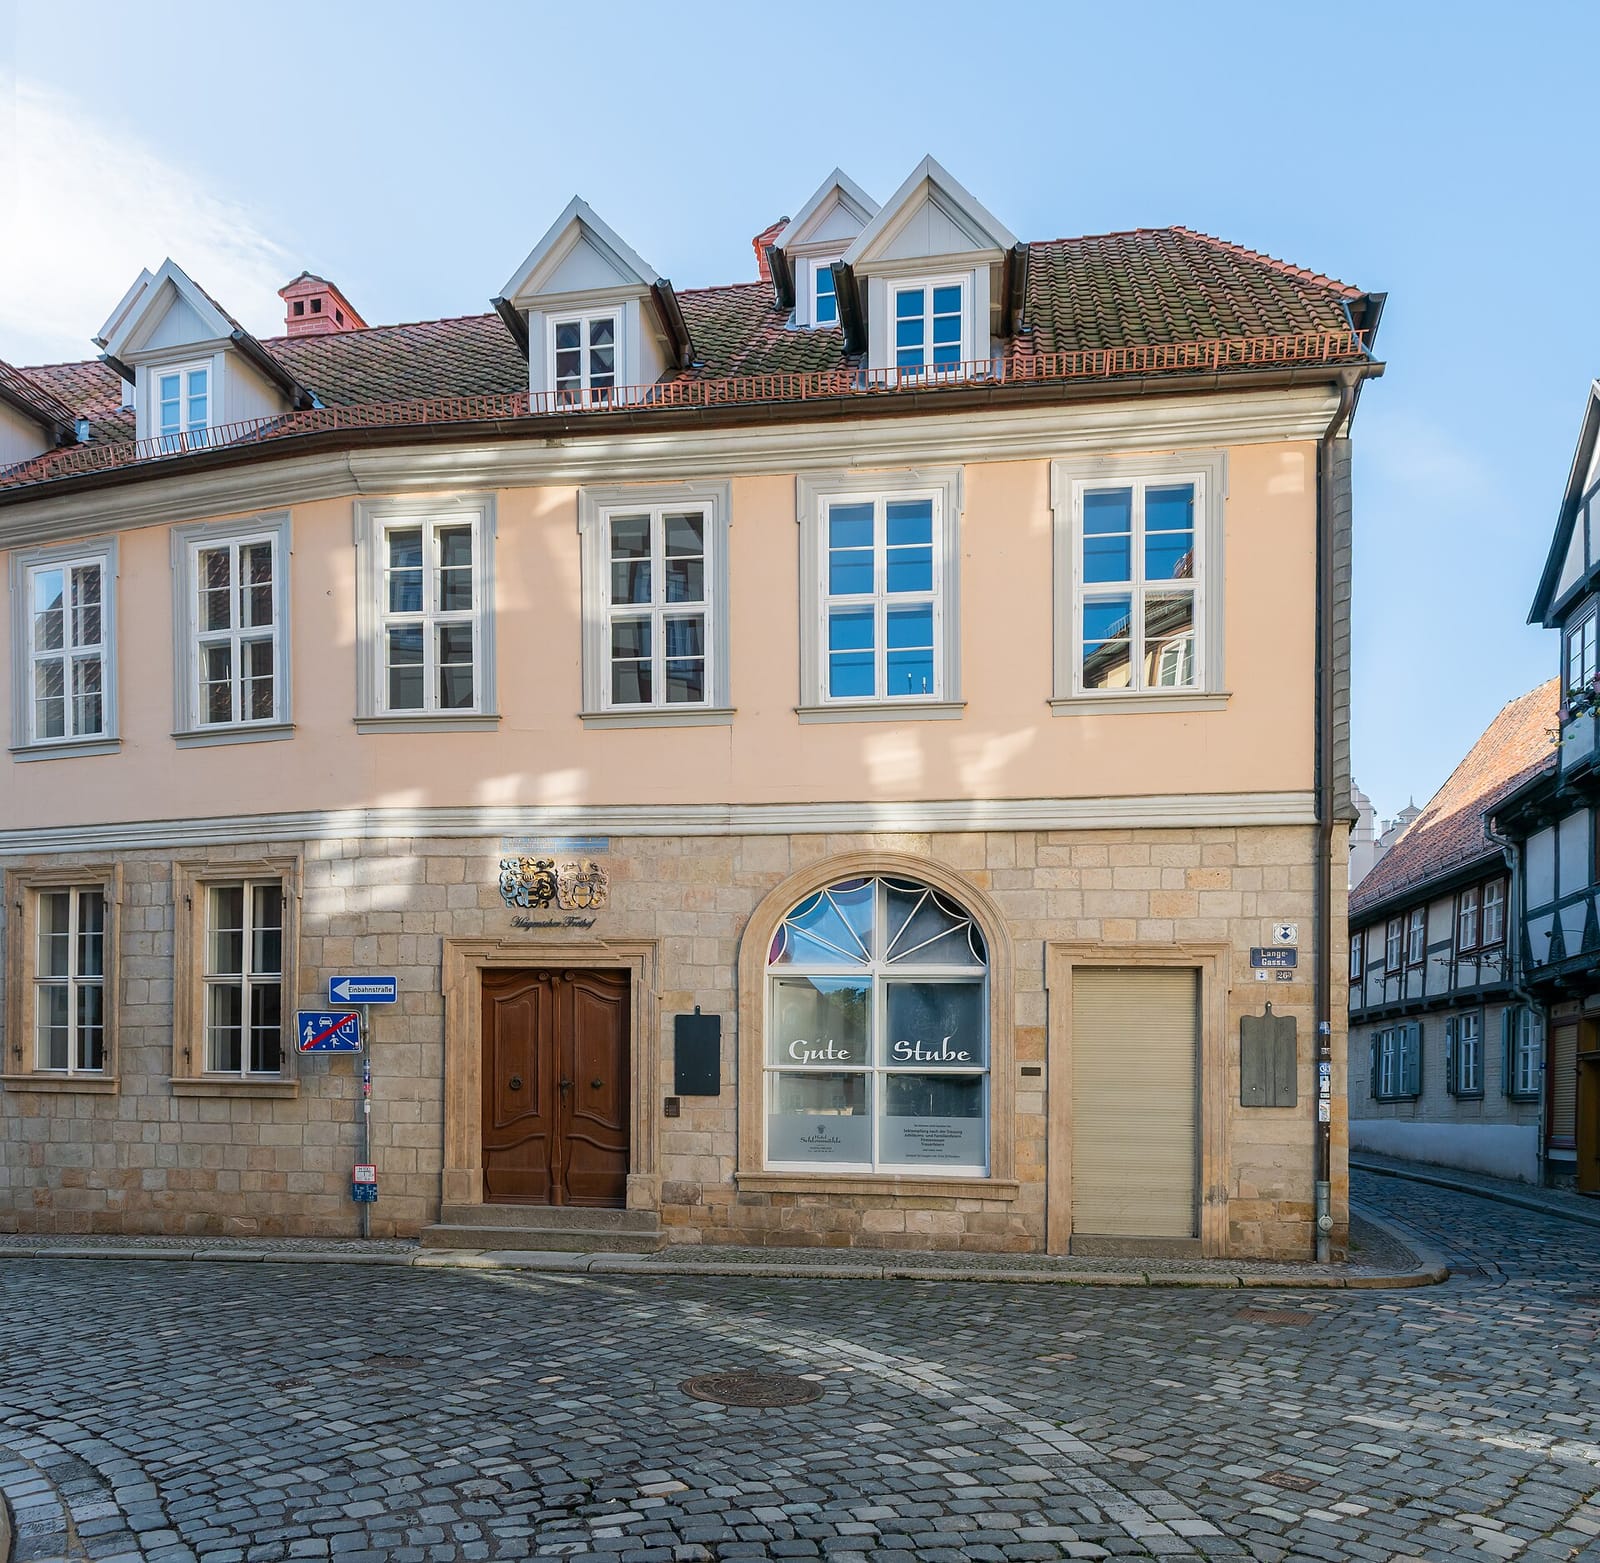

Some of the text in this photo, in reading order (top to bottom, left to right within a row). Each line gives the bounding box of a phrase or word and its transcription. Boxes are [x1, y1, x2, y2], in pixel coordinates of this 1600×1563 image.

[348, 985, 393, 994] Einbahnstraße
[788, 1036, 972, 1064] Gute Stube
